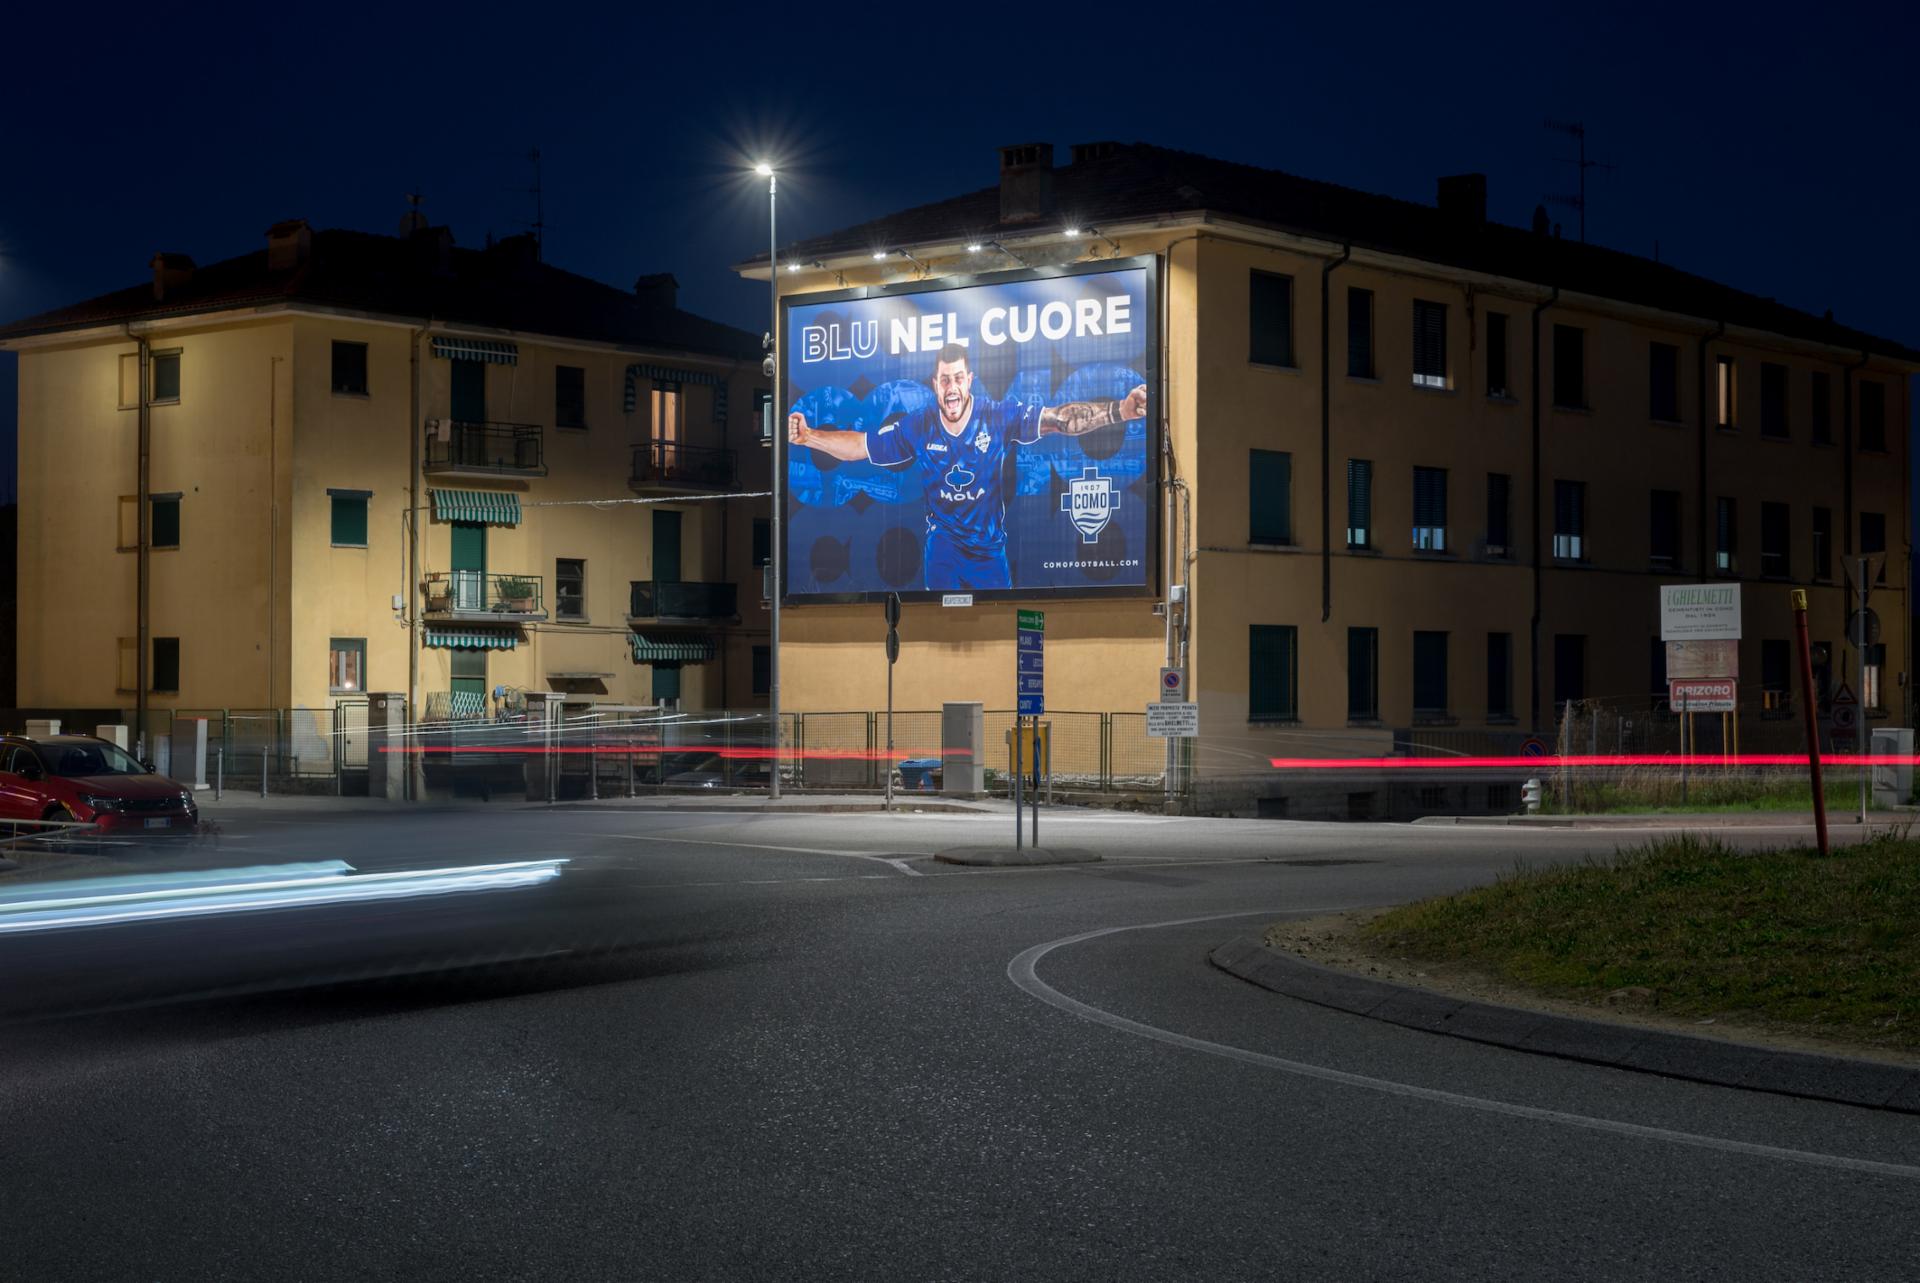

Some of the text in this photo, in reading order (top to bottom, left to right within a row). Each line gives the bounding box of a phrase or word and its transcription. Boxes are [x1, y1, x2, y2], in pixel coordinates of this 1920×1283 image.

[803, 295, 1131, 363] BLU NEL CUORE
[1074, 493, 1107, 509] COMO
[1043, 560, 1139, 568] COMOFOOTBALL.COM
[1673, 588, 1733, 606] GHIELMETTI
[1676, 685, 1730, 696] DRIZORO
